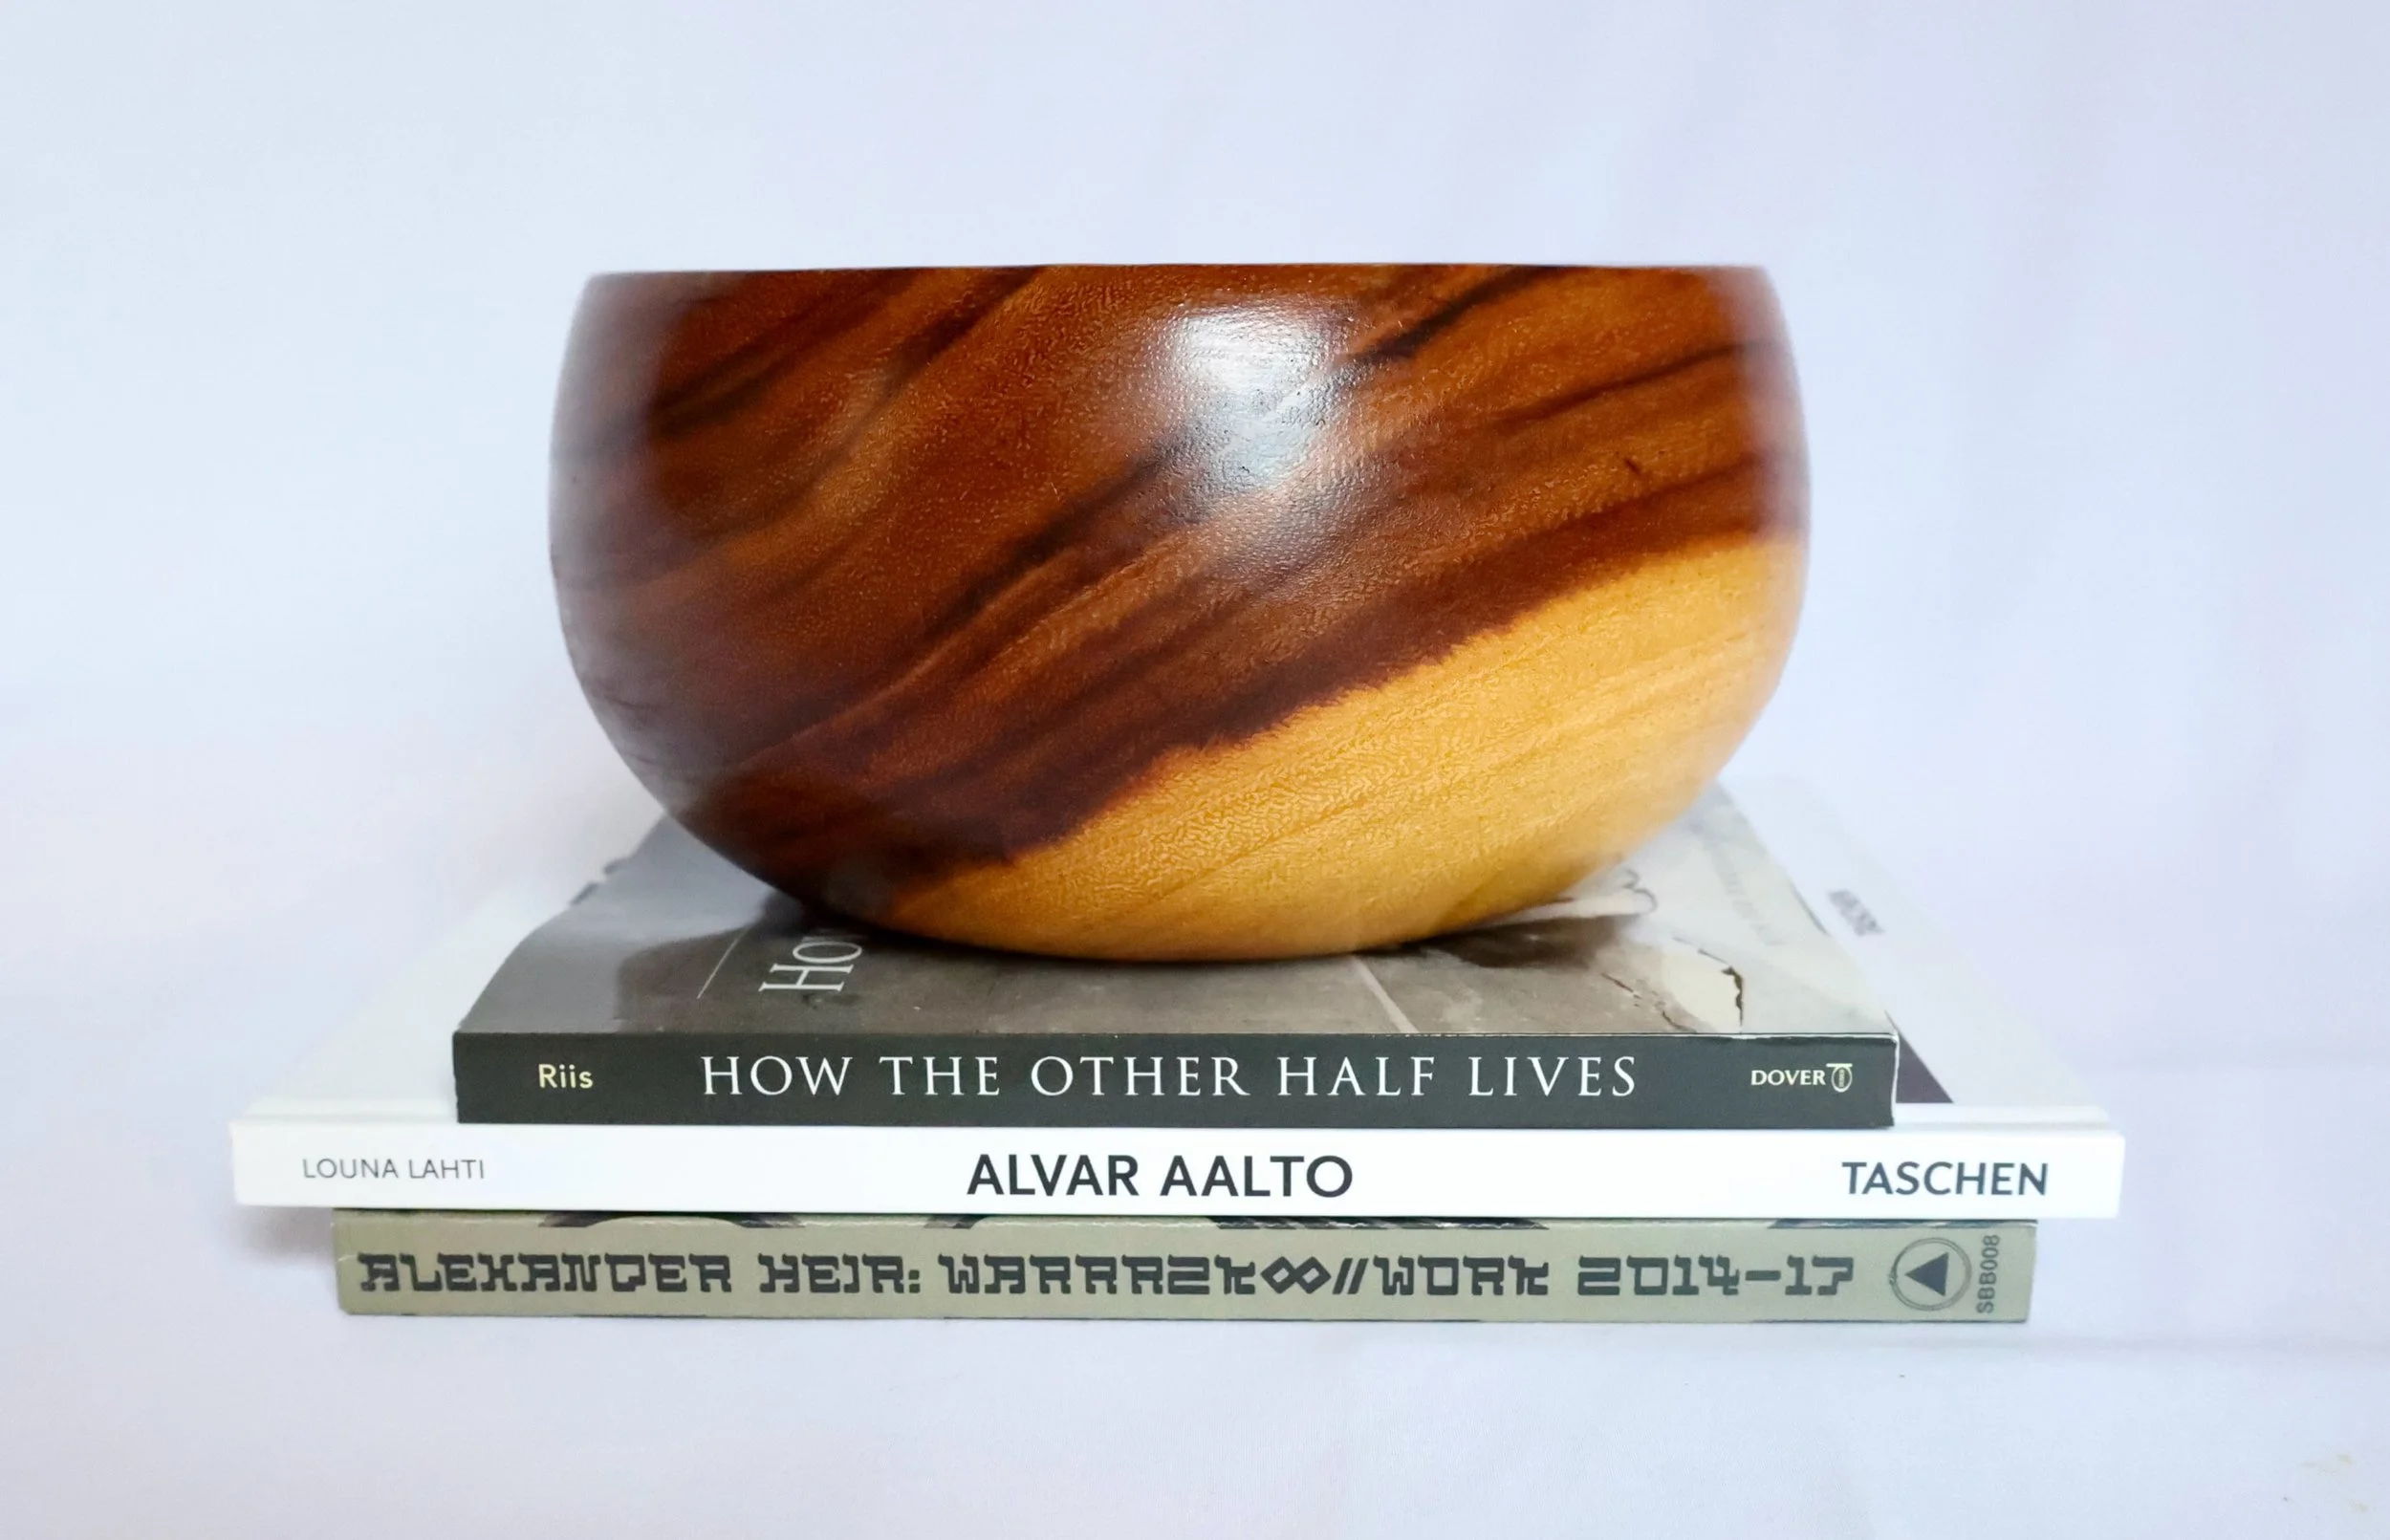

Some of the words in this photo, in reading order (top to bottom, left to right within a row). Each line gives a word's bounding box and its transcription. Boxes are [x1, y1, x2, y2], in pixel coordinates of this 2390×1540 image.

[758, 932, 863, 992] HO
[538, 1063, 594, 1089] Riis
[702, 1055, 853, 1095] HOW
[880, 1056, 1000, 1095] THE
[1031, 1055, 1250, 1096] OTHER
[1278, 1056, 1435, 1096] HALF
[1468, 1055, 1635, 1096] LIVES
[1750, 1069, 1826, 1086] DOVER
[302, 1158, 399, 1180] LOUNA
[408, 1159, 485, 1180] LAHTI
[967, 1154, 1140, 1197] ALVAR
[1160, 1155, 1353, 1198] AALTO
[1841, 1160, 2048, 1196] TASCHEN
[357, 1252, 732, 1293] ALEXANDER
[757, 1252, 921, 1294] HEIR:
[1576, 1254, 1854, 1296] 2014-17
[1975, 1234, 2000, 1313] SBB008
